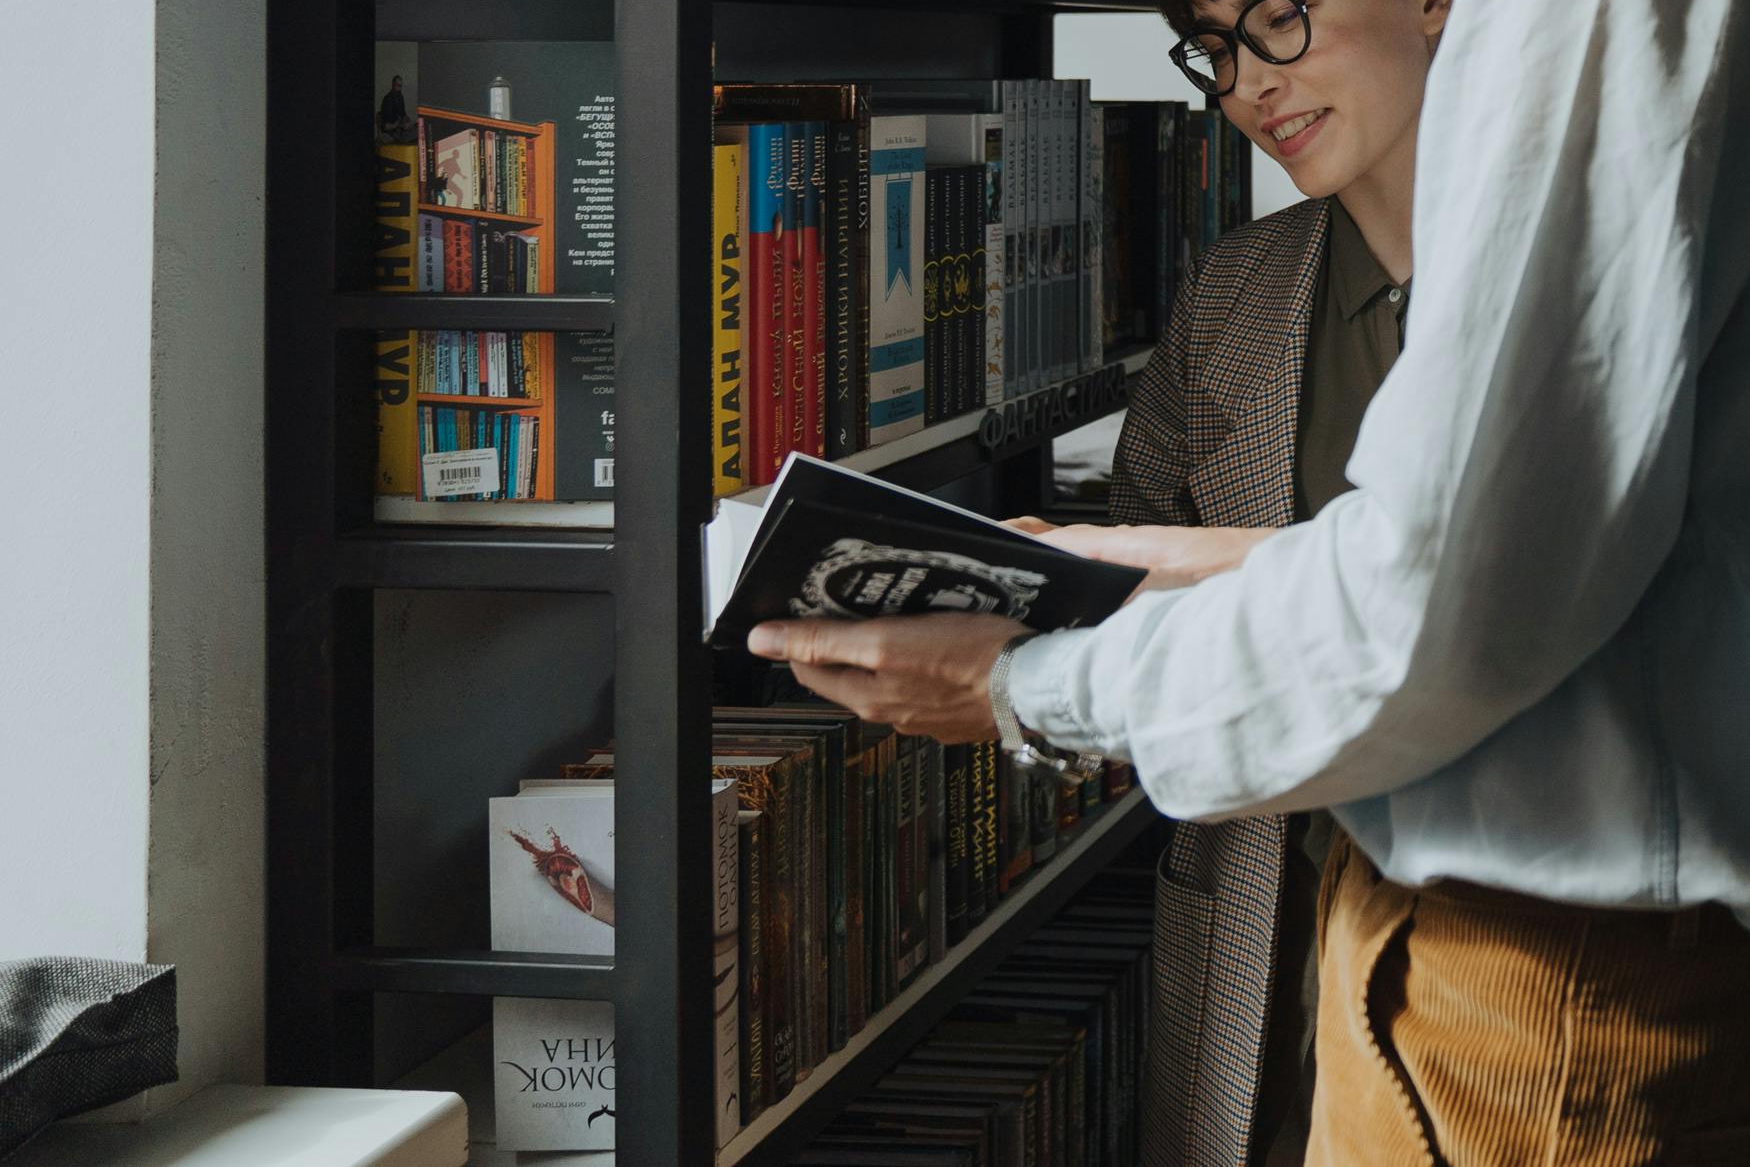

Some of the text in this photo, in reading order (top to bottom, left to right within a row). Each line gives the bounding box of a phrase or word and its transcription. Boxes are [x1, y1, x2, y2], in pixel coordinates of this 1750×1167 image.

[766, 138, 777, 189] Филип
[786, 139, 799, 190] Филип
[810, 136, 821, 186] Филип
[858, 143, 868, 229] ХОББИТ
[837, 179, 849, 401] ХРОНИКИ НАРНИИ
[721, 233, 741, 479] АЛАН МУР
[978, 363, 1128, 456] ФАНТАСТИКА
[900, 761, 912, 820] КИНГ
[718, 803, 729, 930] ПОТОМОК
